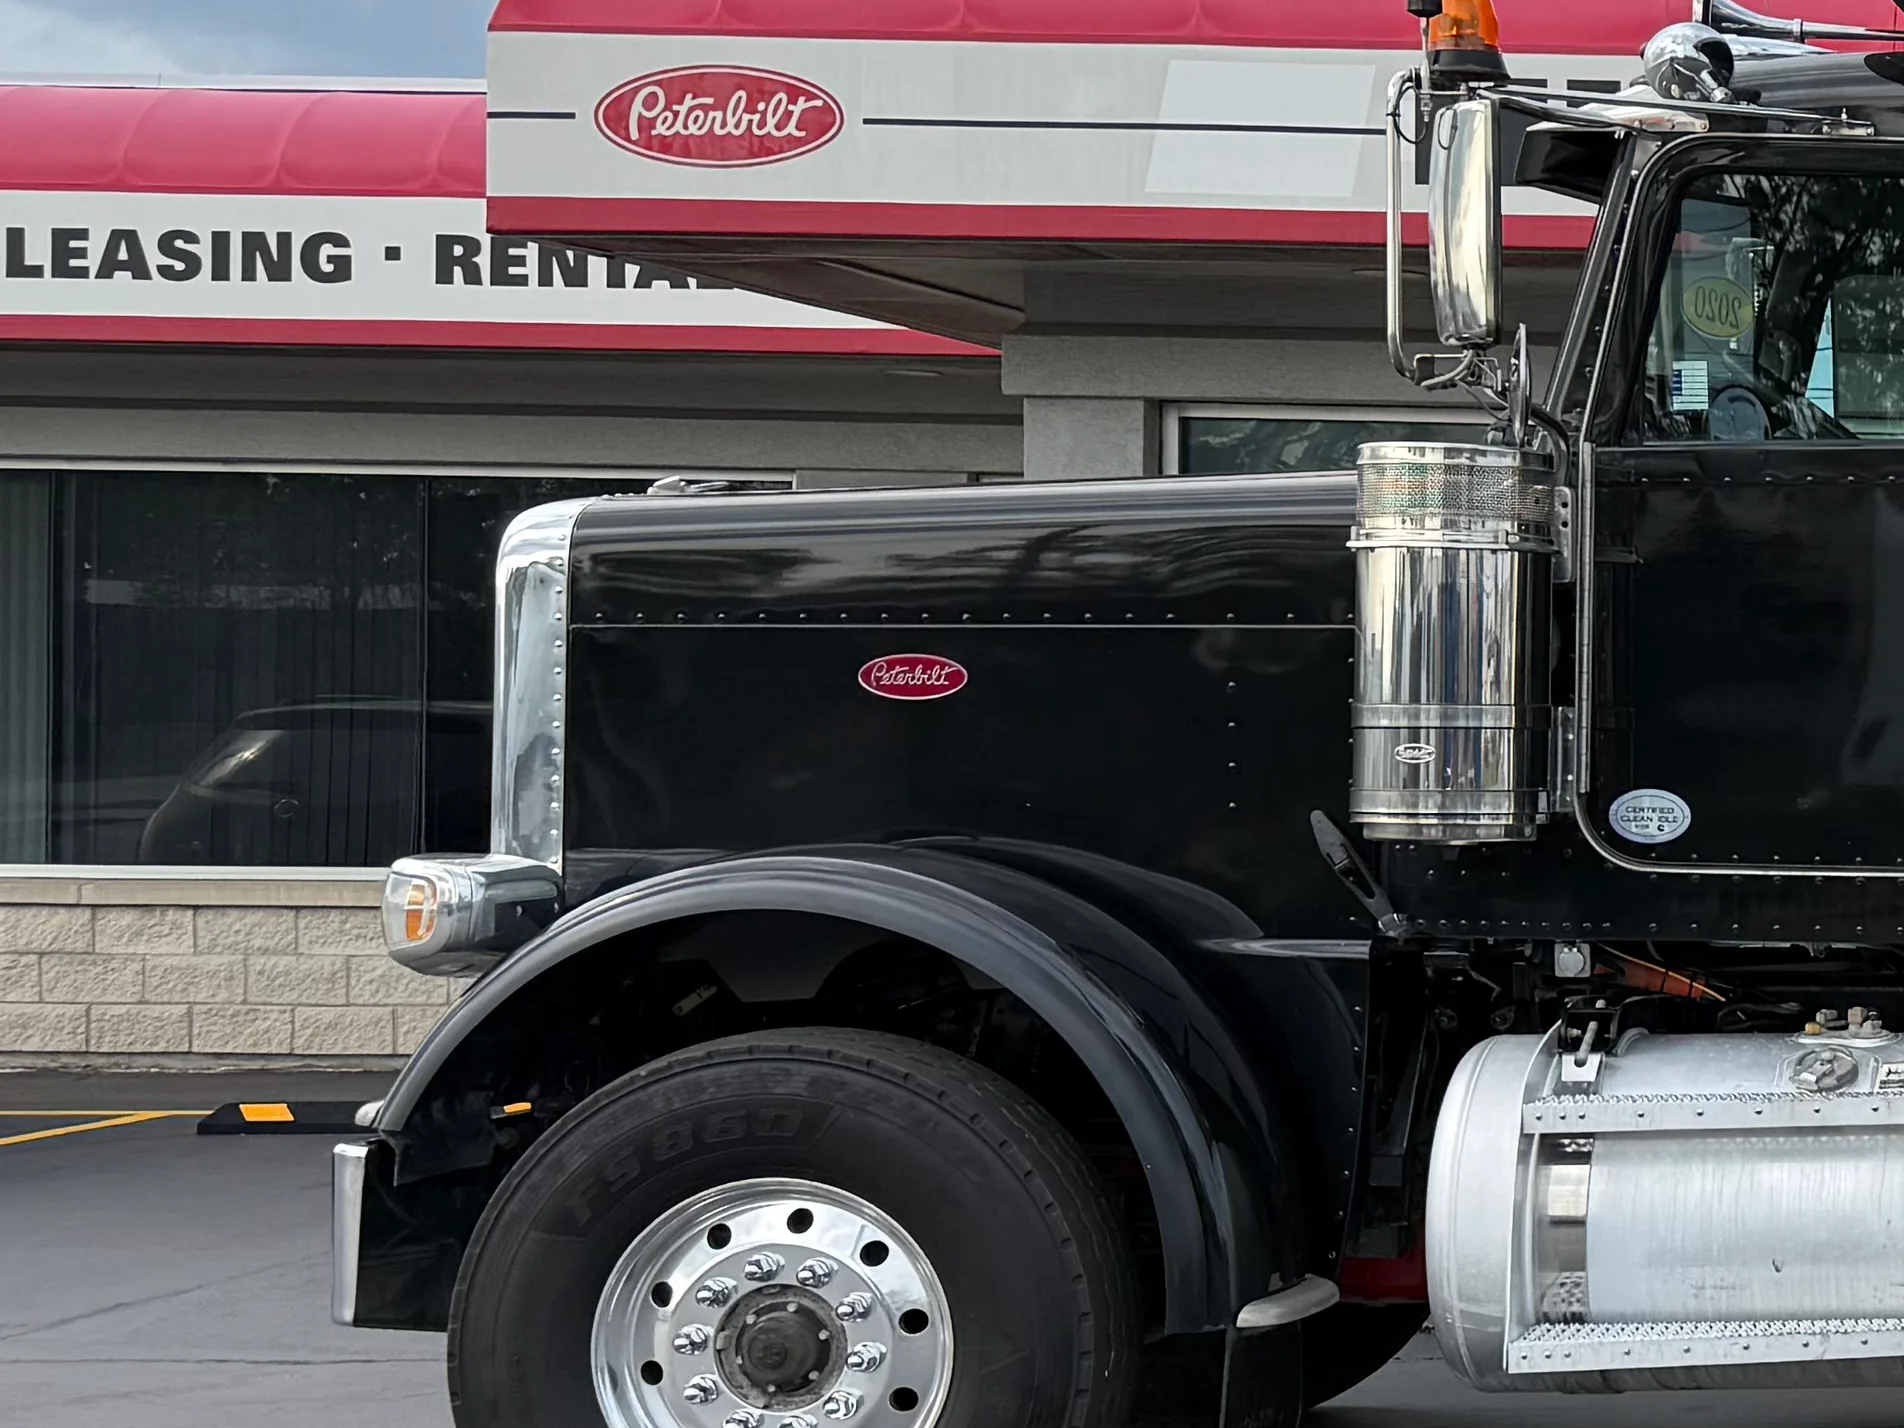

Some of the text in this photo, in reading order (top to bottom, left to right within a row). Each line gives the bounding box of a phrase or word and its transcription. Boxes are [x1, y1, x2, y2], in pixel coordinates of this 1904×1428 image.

[628, 85, 825, 141] Peterbilt
[5, 226, 740, 290] LEASING REN
[871, 661, 961, 687] Peterbilt
[1619, 814, 1680, 824] CLEAN IDLE
